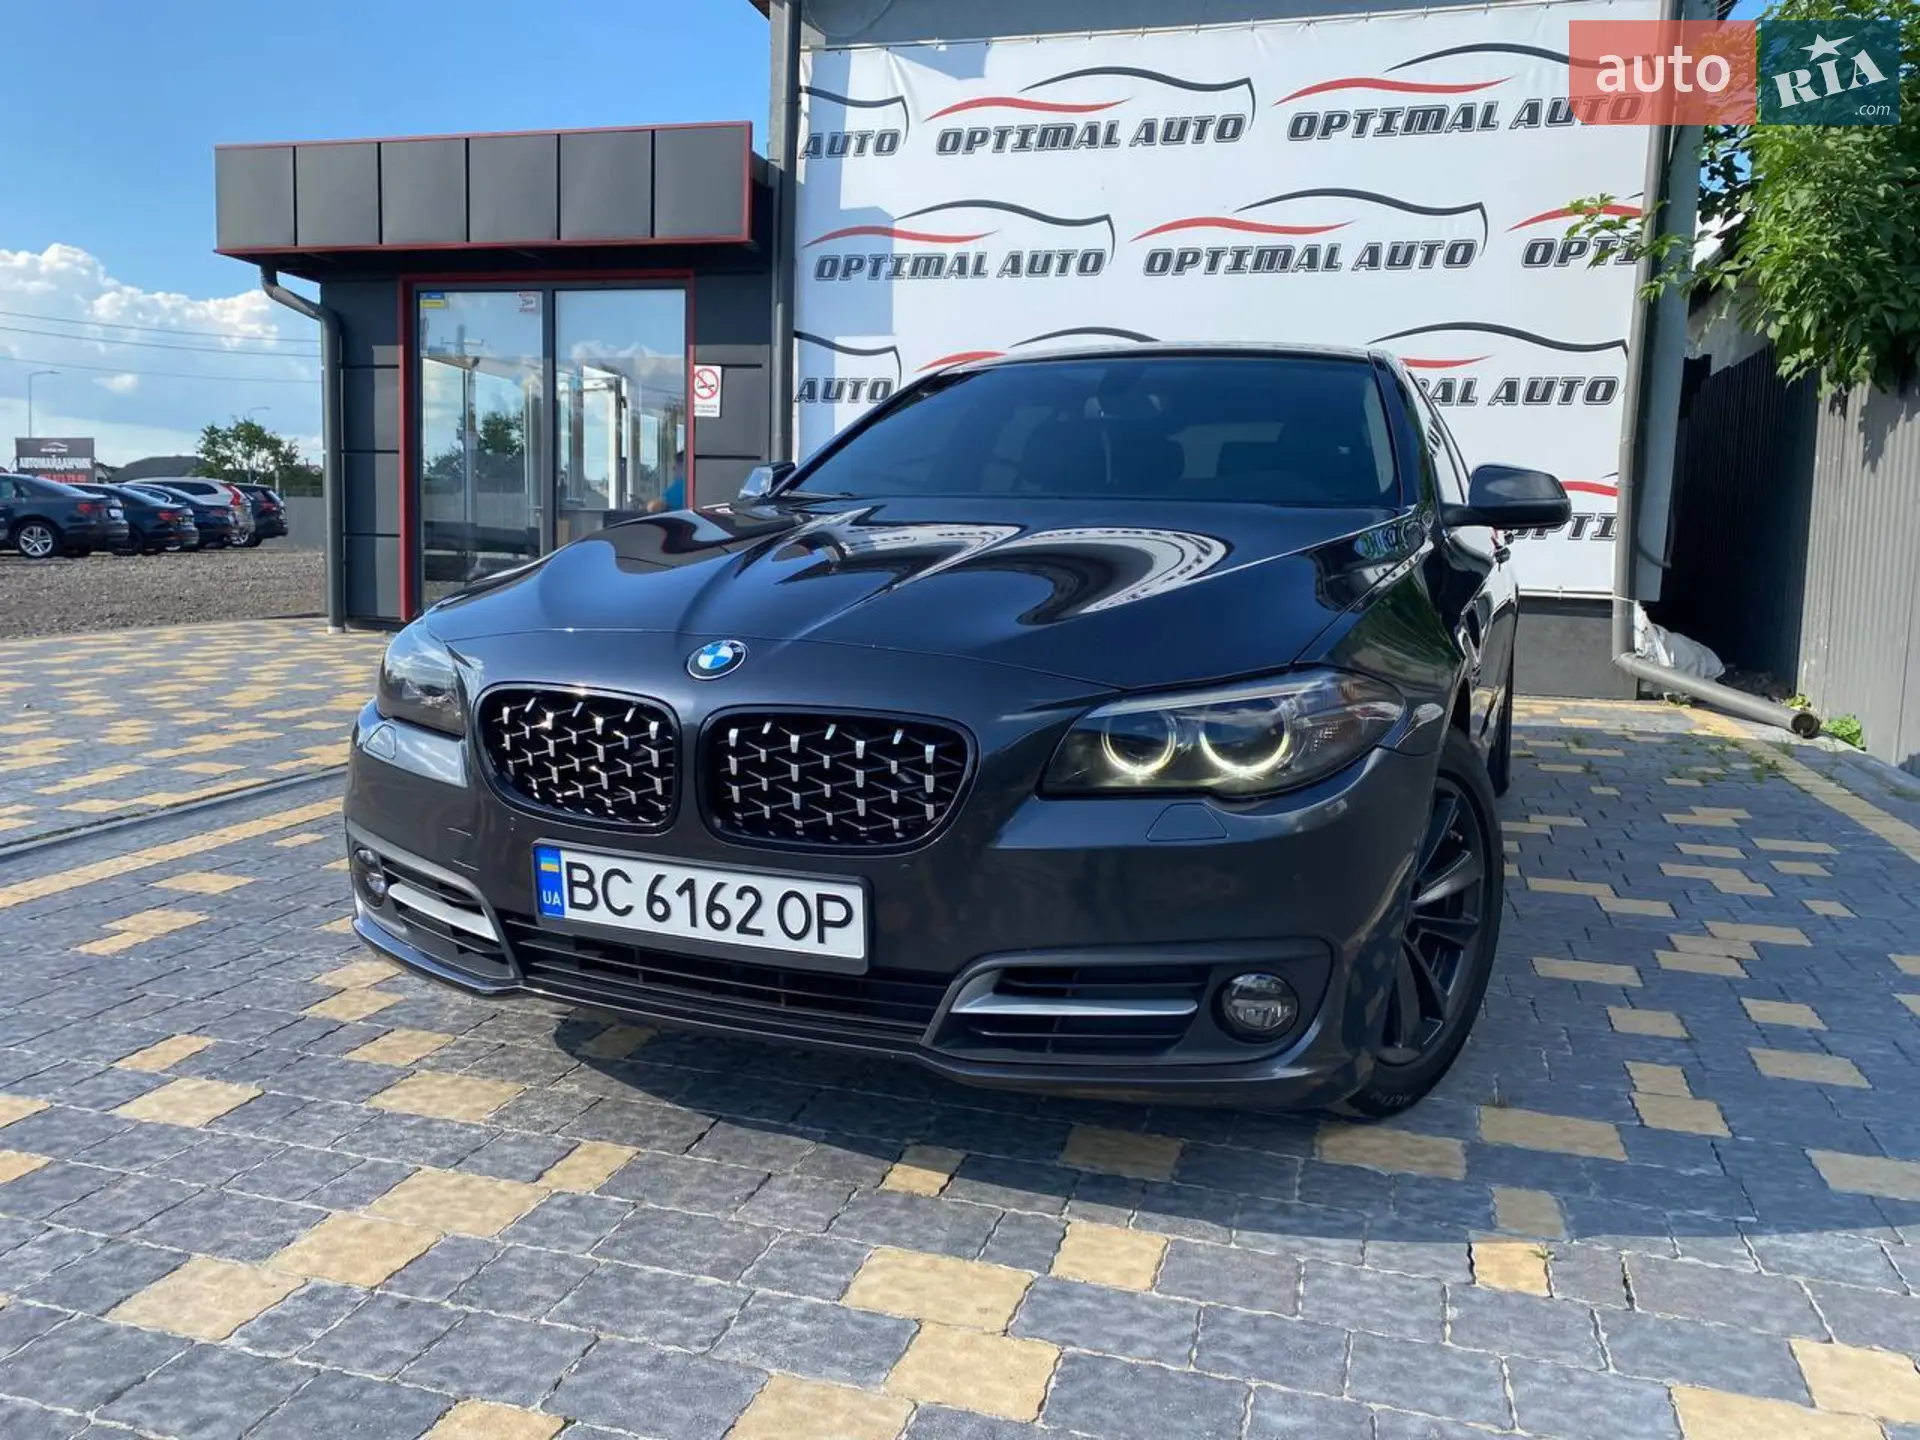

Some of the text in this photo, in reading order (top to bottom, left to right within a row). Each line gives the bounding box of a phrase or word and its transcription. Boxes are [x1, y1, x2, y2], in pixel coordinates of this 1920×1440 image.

[1286, 93, 1645, 141] OPTIMAL AUTO
[799, 129, 901, 160] AUTO
[936, 113, 1248, 155] OPTIMAL AUTO
[814, 248, 1107, 281] OPTIMAL AUTO
[1143, 239, 1478, 276] OPTIMAL AUTO
[794, 377, 895, 404] AUTO
[1488, 376, 1620, 406] AUTO
[541, 889, 562, 907] UA
[565, 861, 853, 944] BC 6162 OP
